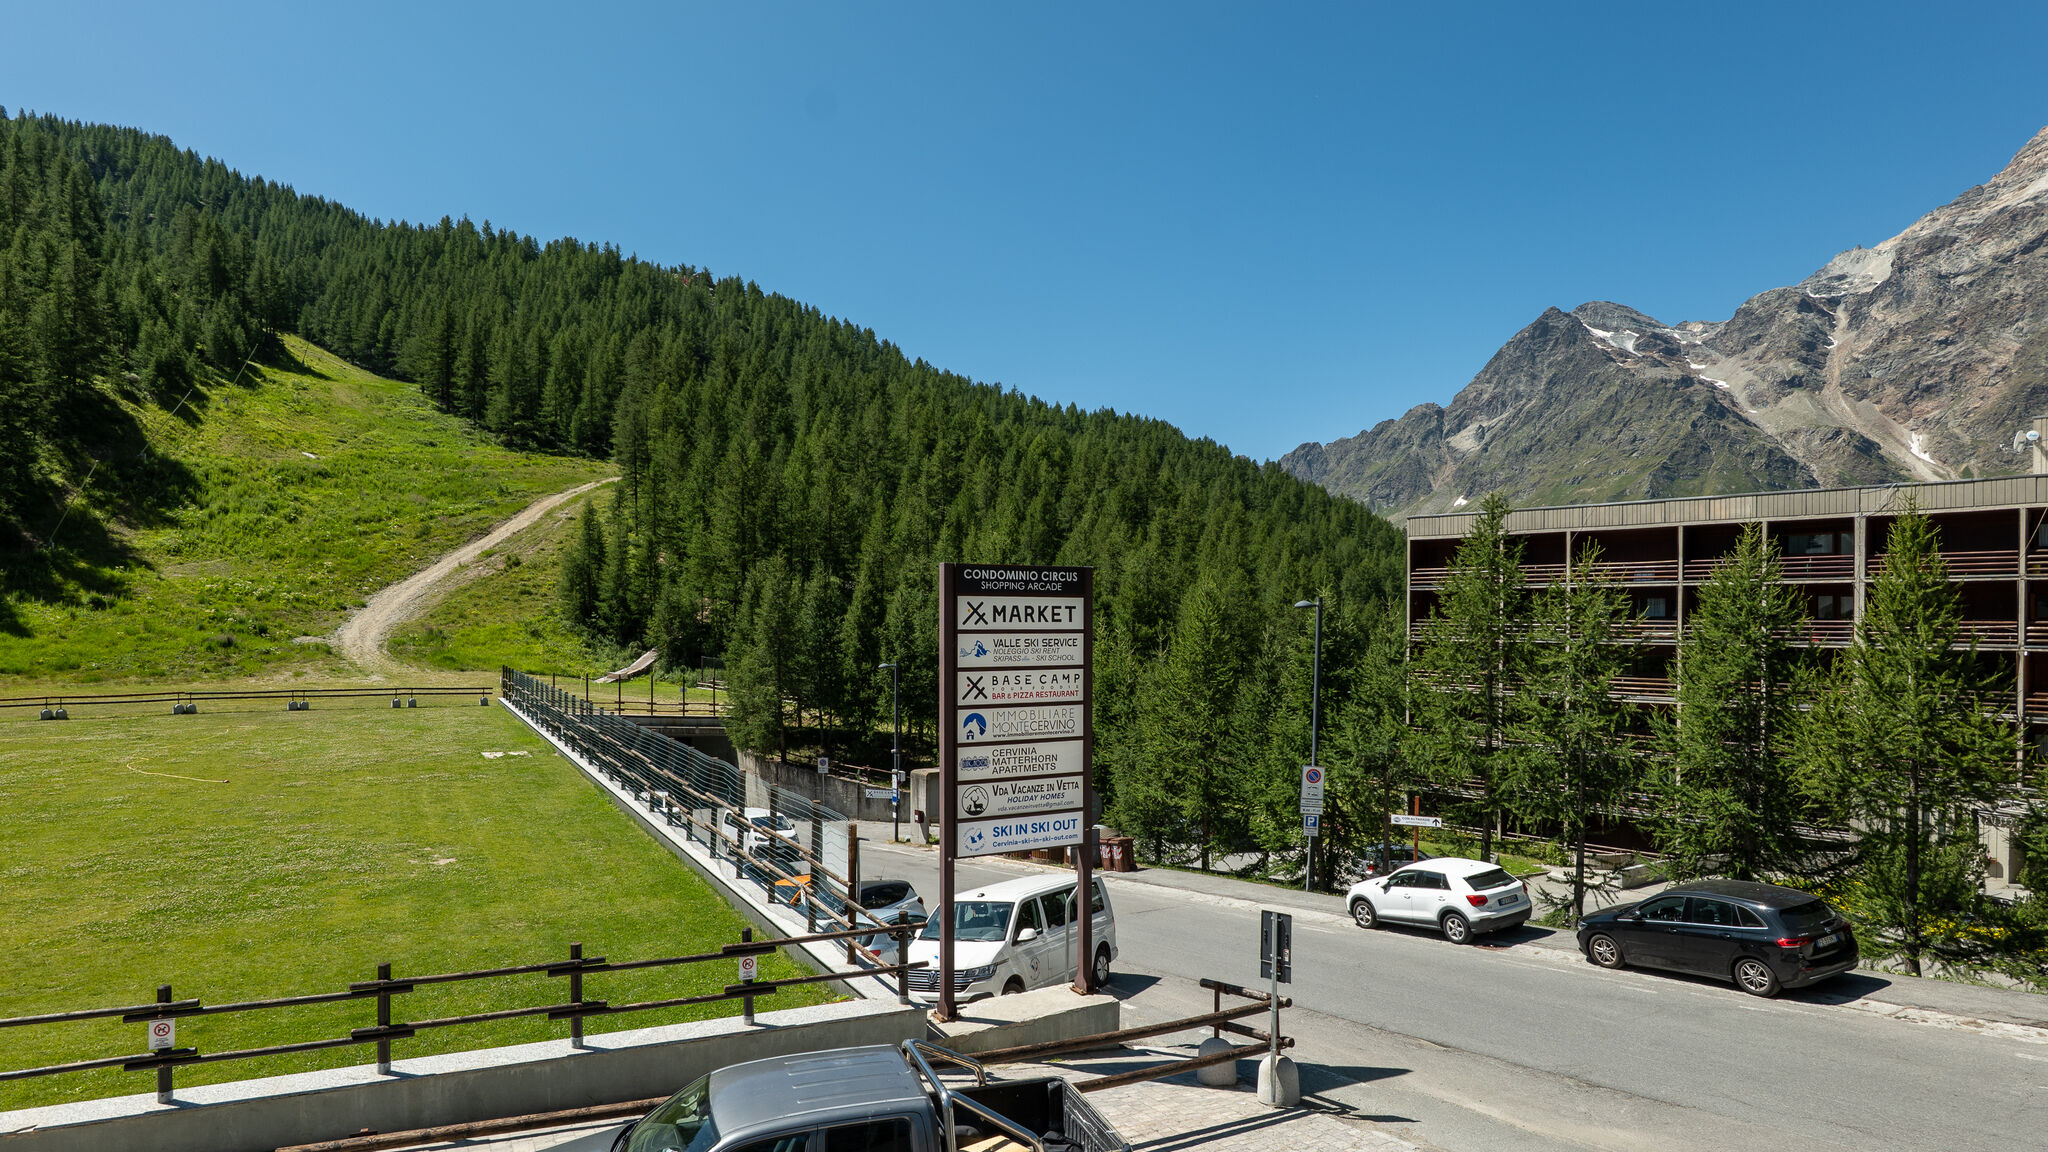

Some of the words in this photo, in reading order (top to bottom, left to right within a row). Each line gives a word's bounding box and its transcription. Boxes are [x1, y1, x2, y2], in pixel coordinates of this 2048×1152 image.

[964, 569, 1038, 580] CONDOMINIO
[1041, 571, 1078, 582] CIRCUS
[981, 581, 1025, 590] SHOPPING
[1027, 582, 1062, 590] ARCADE
[992, 605, 1076, 622] MARKET
[993, 638, 1020, 648] VALLE
[1024, 638, 1039, 648] SKI
[1042, 638, 1078, 647] SERVICE
[992, 674, 1032, 686] BASE
[1040, 674, 1080, 684] CAMP
[1036, 690, 1079, 698] RESTAURANT
[992, 708, 1075, 721] IMMOBILIARE
[992, 719, 1076, 733] MONTECERVINO
[993, 730, 1075, 738] www.immobiliaremontecervino.it
[992, 747, 1037, 758] CERVINIA
[992, 754, 1058, 766] MATTERHORN
[992, 762, 1056, 774] APARTMENTS
[1007, 794, 1039, 804] HOLIDAY
[998, 800, 1074, 812] vda.vacanzeinvetta@gmail.com
[993, 826, 1012, 838] SKI
[1016, 824, 1028, 835] IN
[1031, 821, 1050, 833] SKI
[1053, 819, 1078, 831] OUT
[992, 833, 1078, 848] Cervinia-ski-in-ski-out.com
